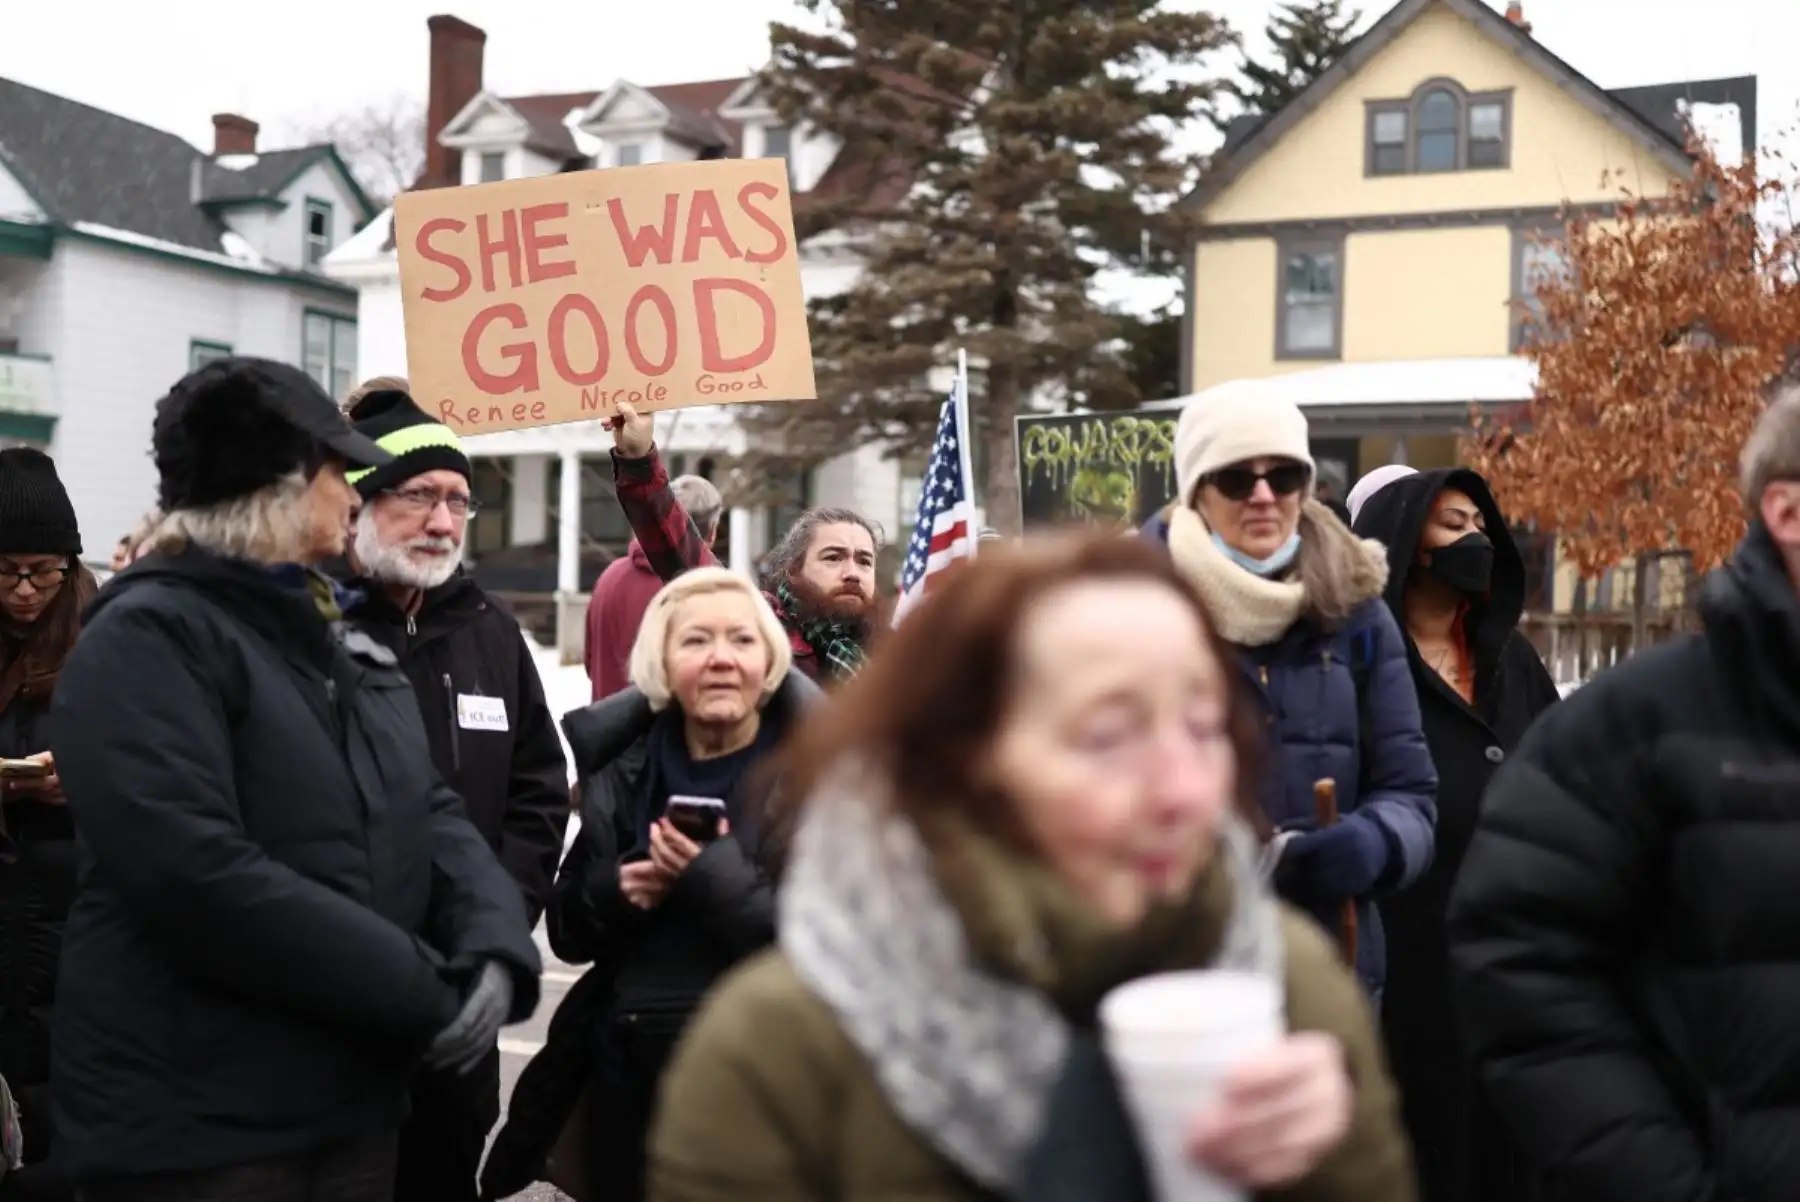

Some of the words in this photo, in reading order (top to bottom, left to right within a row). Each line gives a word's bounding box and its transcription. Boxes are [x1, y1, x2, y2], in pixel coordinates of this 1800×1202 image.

[415, 202, 577, 302] SHE
[608, 181, 788, 268] WAS
[461, 278, 777, 395] GOOD
[438, 398, 546, 426] Renee
[581, 382, 668, 410] Nicole
[695, 373, 768, 395] Good
[1023, 416, 1177, 466] COWARDS
